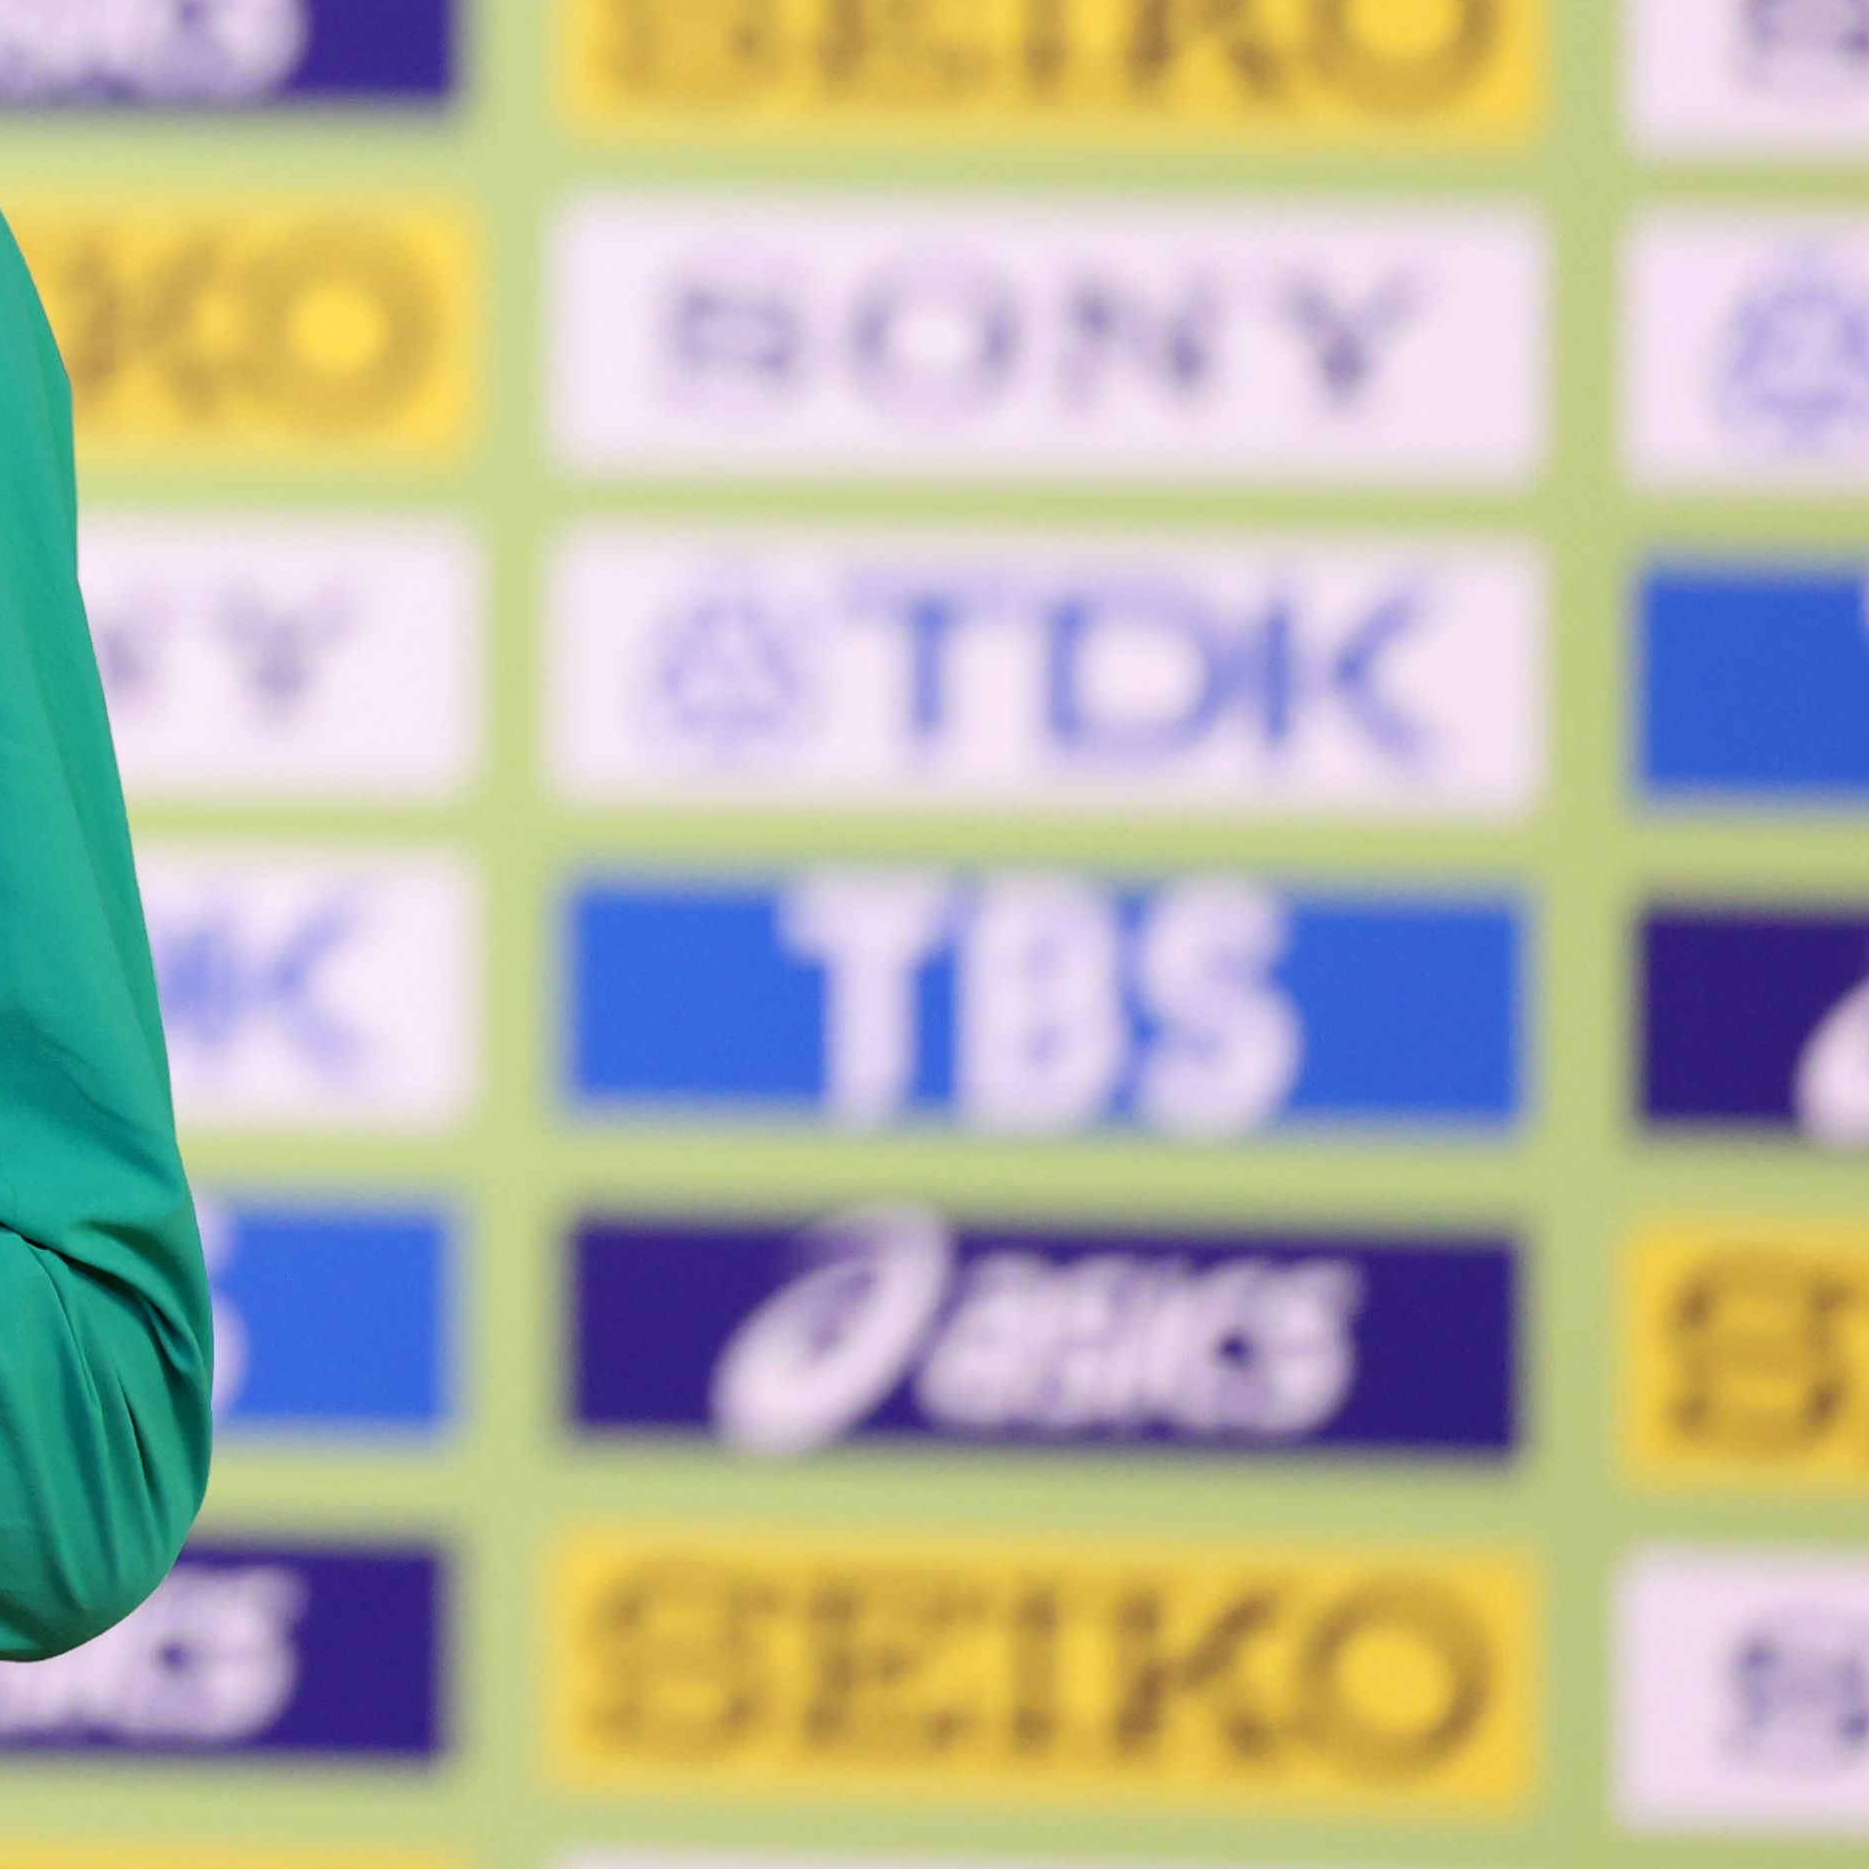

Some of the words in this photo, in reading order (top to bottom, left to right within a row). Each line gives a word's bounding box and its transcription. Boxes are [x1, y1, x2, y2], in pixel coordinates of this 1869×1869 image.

[651, 260, 1419, 405] SONY
[826, 565, 1439, 768] TDK
[780, 875, 1303, 1128] TBS
[921, 1252, 1361, 1432] asics
[574, 1555, 1495, 1782] SEIKO
